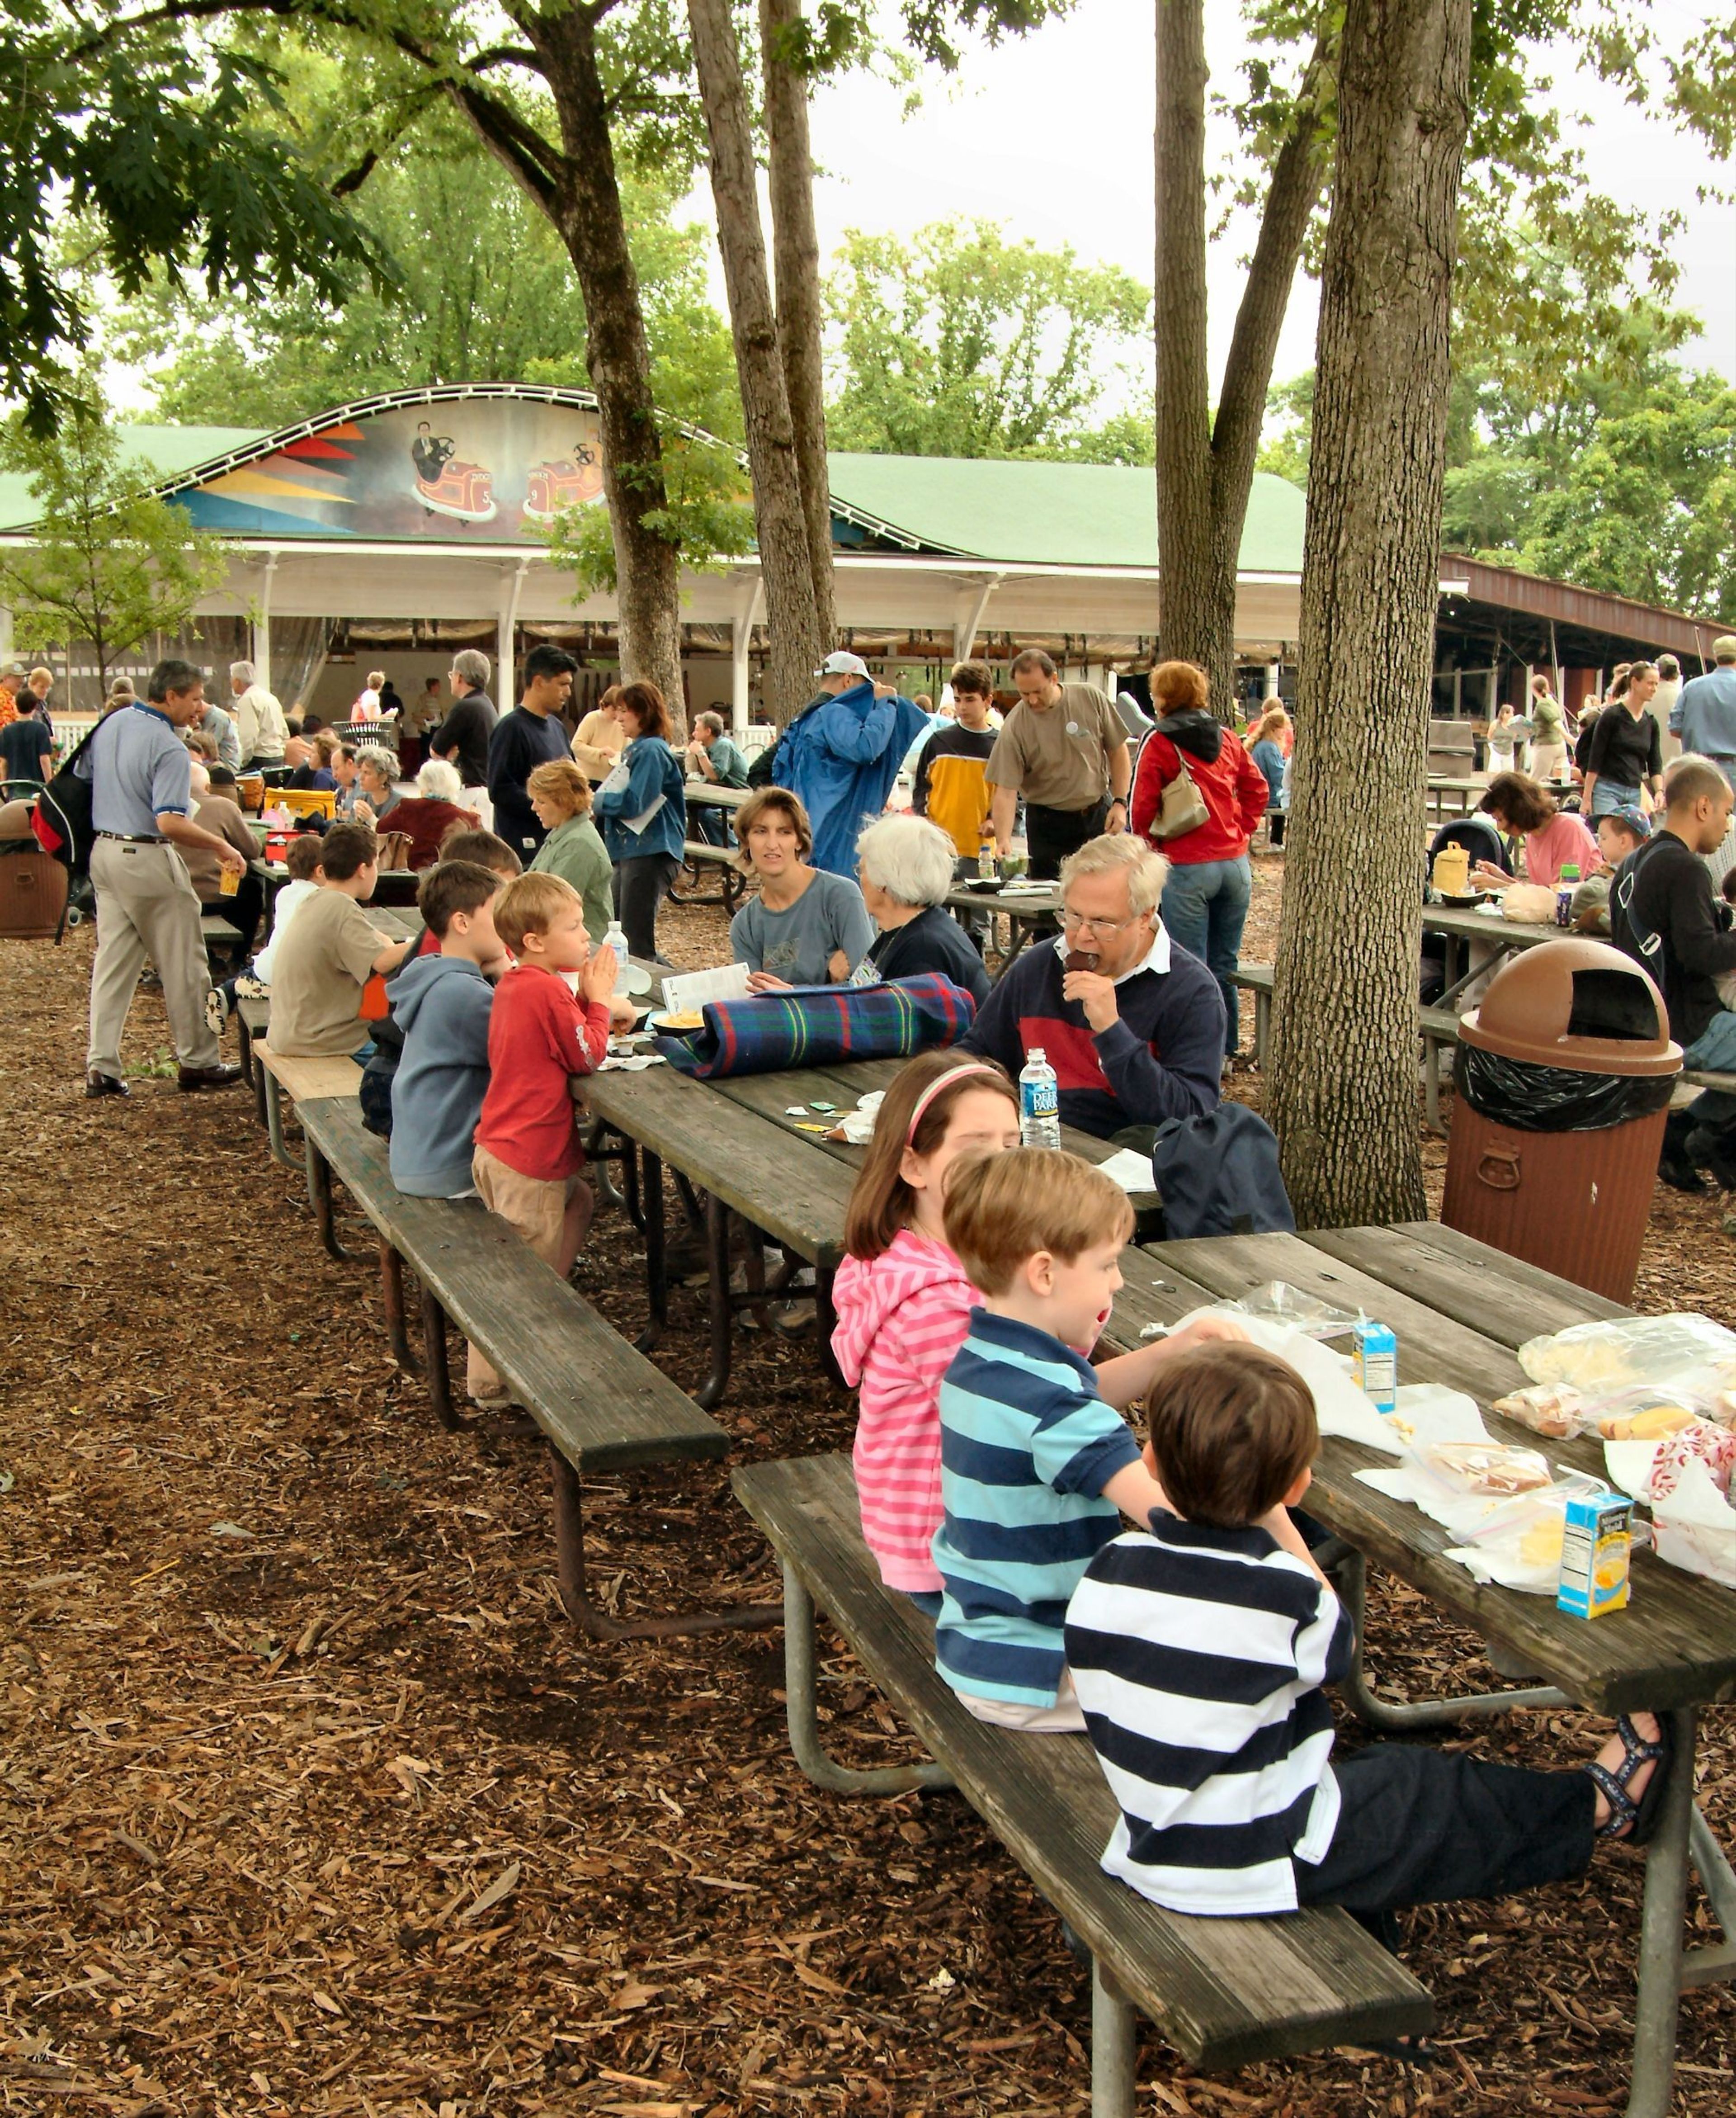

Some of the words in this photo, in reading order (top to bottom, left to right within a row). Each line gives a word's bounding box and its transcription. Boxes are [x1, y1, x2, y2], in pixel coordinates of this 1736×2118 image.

[482, 491, 490, 503] 5
[531, 490, 538, 501] 9
[1033, 1091, 1057, 1101] DEER
[1033, 1101, 1058, 1111] PARK
